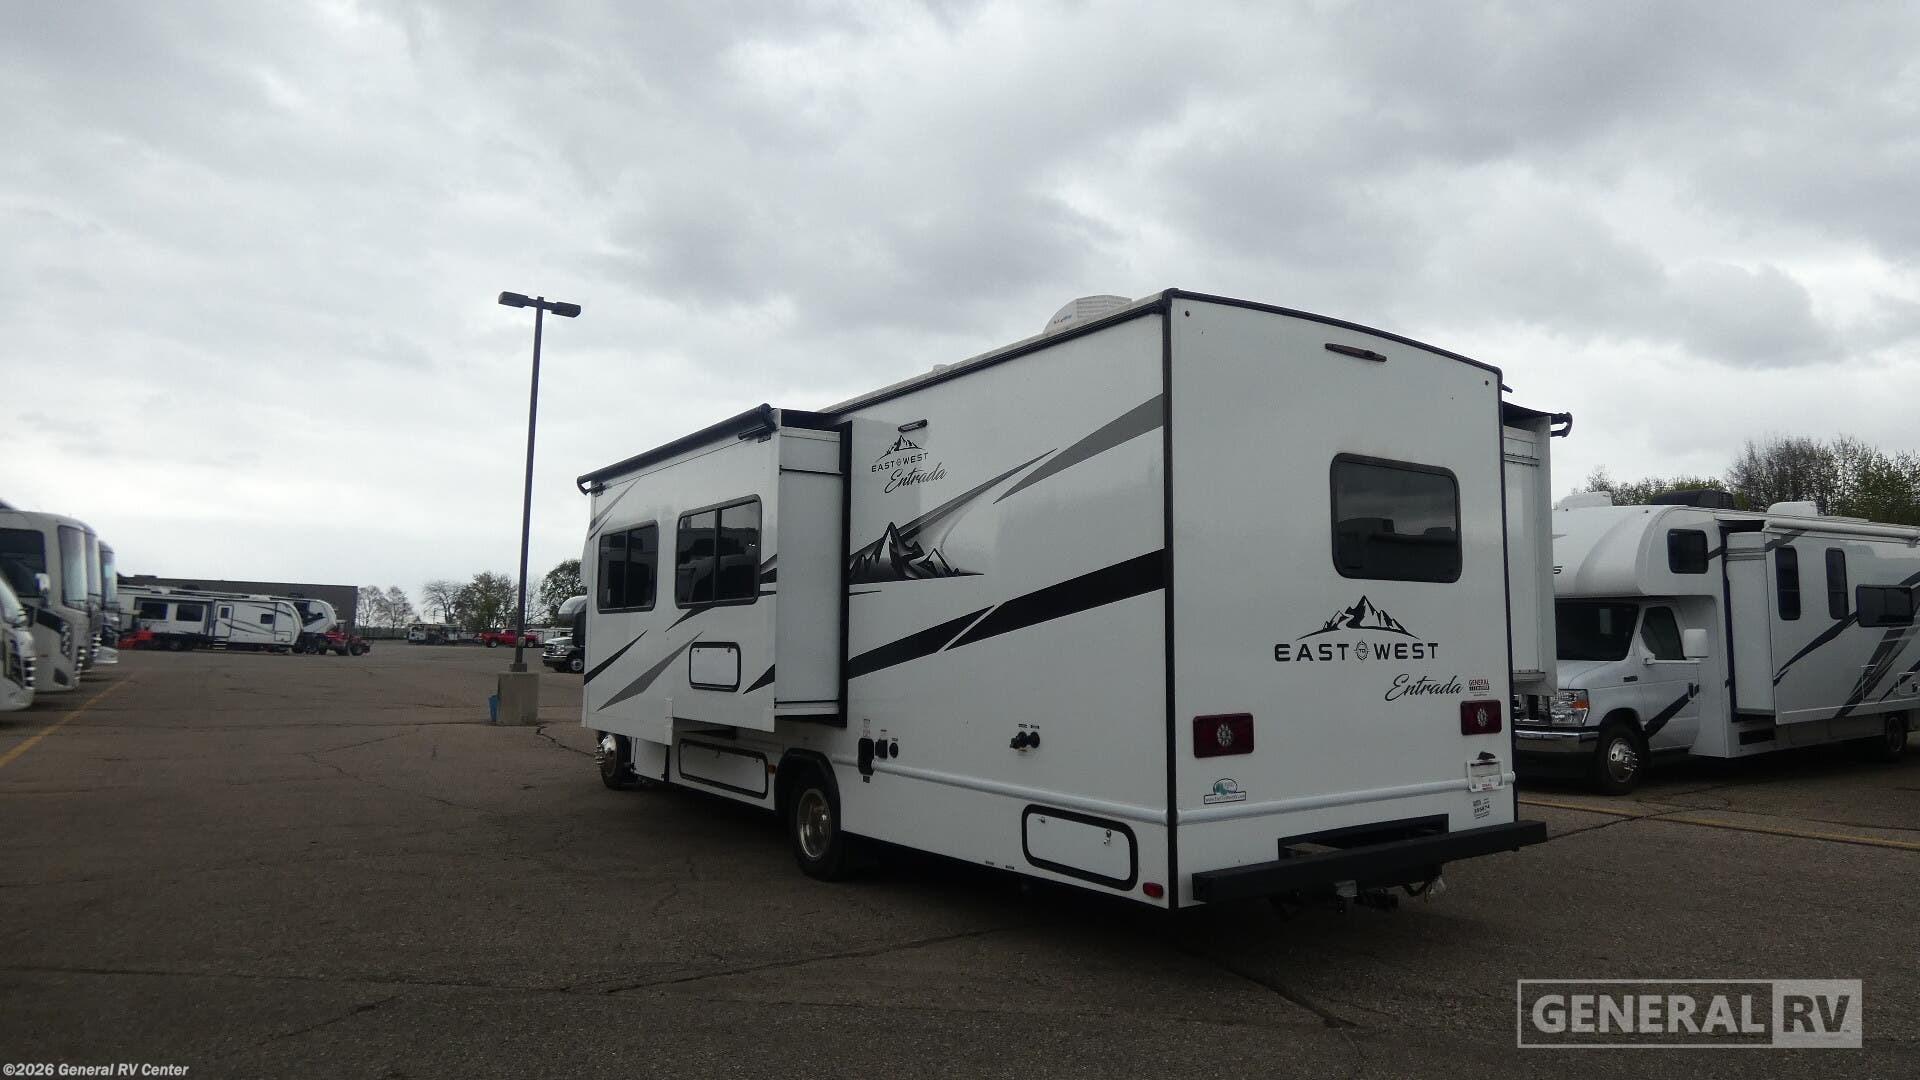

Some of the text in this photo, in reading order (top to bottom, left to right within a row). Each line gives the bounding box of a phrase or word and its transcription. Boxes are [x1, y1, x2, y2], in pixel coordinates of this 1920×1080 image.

[872, 452, 929, 473] EAST WEST
[884, 462, 947, 494] Entrada
[1274, 643, 1350, 662] EAST
[1373, 642, 1439, 660] WEST
[1384, 673, 1463, 702] Entrada
